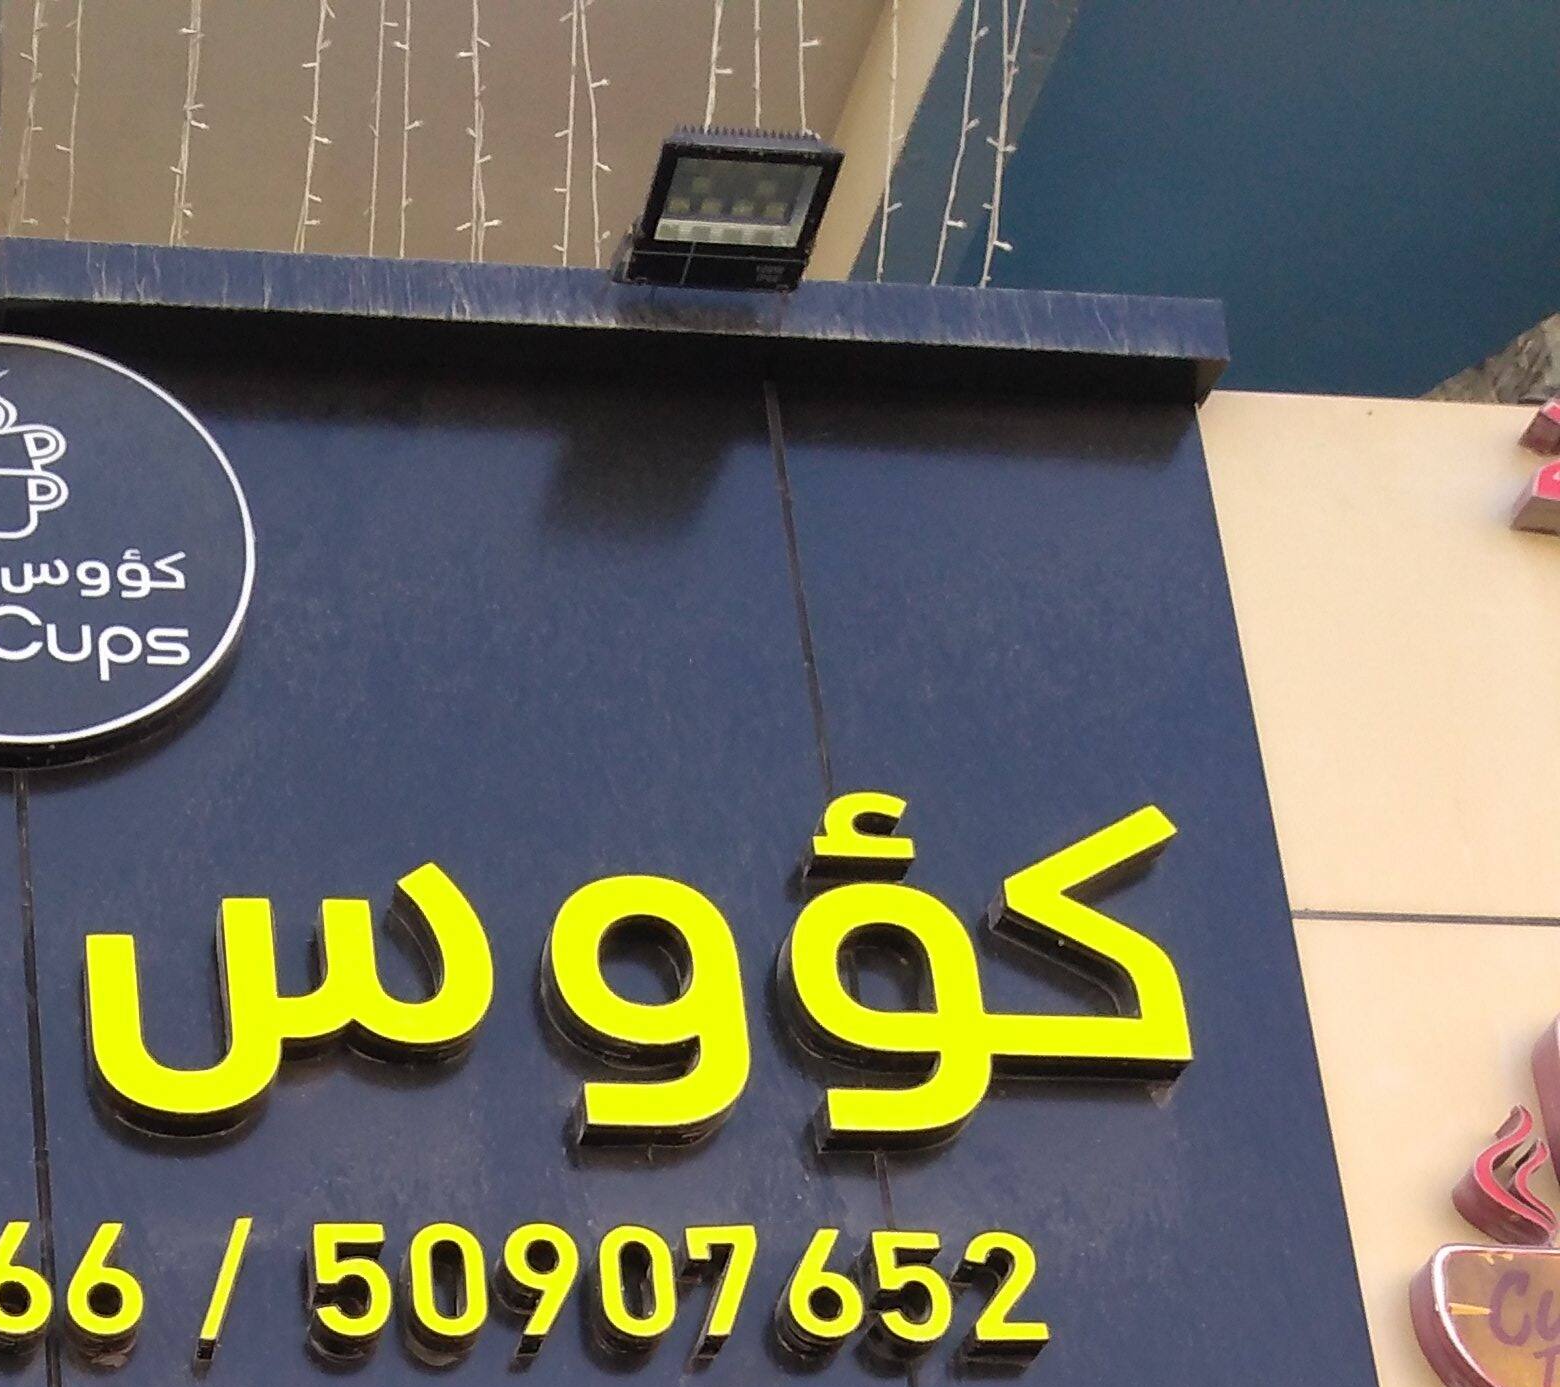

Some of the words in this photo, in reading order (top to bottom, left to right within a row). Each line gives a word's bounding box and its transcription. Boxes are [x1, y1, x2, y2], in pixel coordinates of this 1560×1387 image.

[0, 547, 187, 599] كؤوس
[85, 791, 1192, 1133] كؤوس
[313, 1223, 1048, 1343] 50907652
